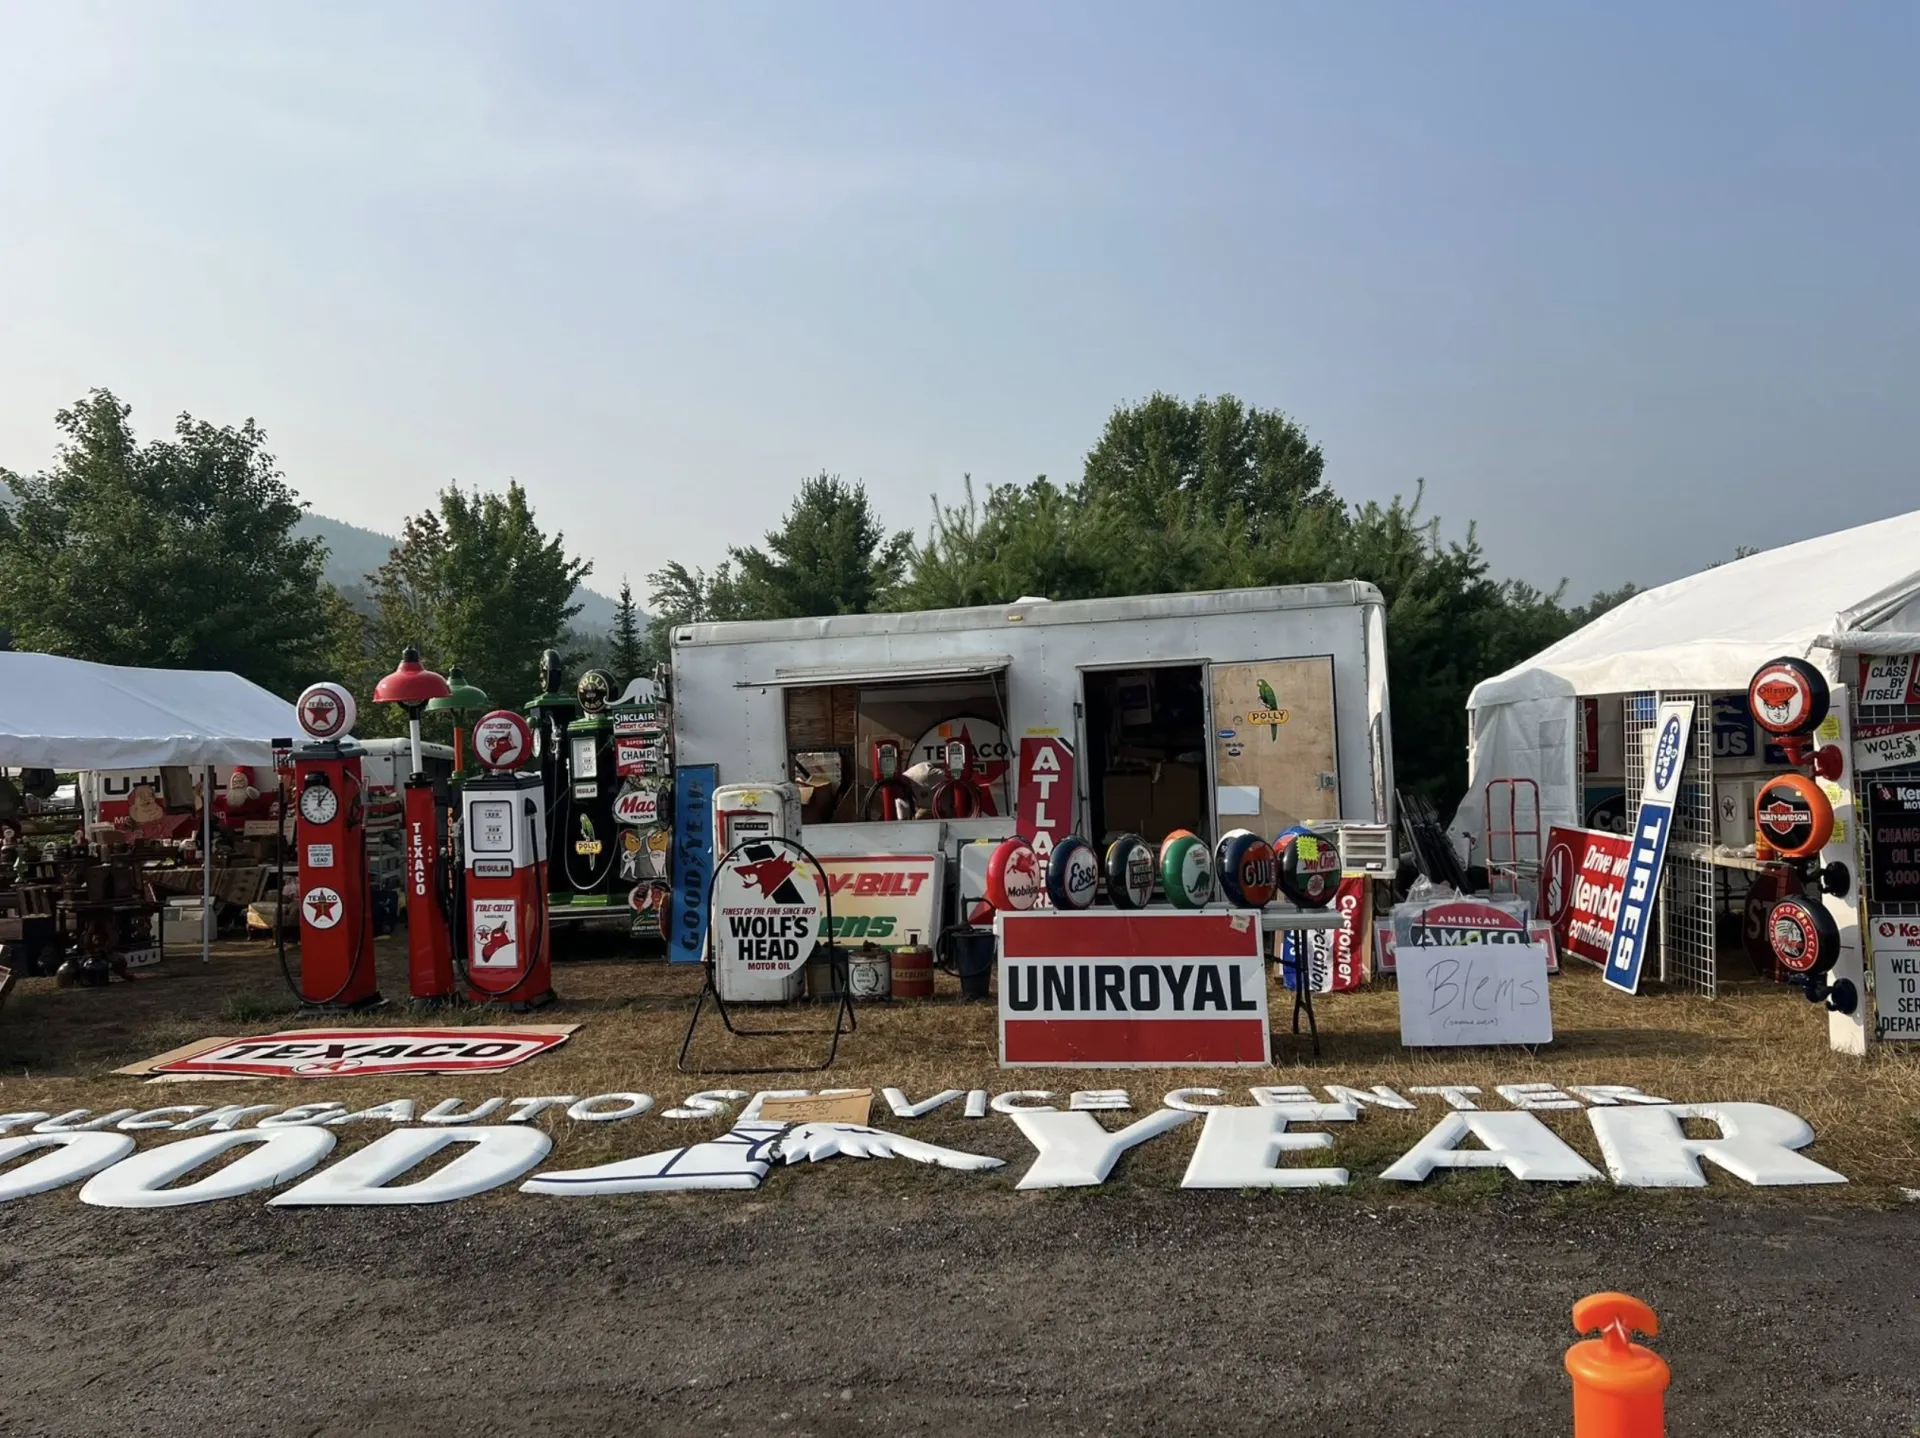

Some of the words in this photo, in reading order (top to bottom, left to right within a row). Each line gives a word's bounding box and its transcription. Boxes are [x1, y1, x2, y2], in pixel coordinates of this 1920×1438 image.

[1886, 656, 1898, 666] IN
[1901, 655, 1909, 666] A
[1872, 667, 1908, 678] CLASS
[1890, 678, 1905, 688] BY
[1866, 689, 1904, 700] ITSELF
[614, 712, 654, 724] SINCLAIR
[1252, 711, 1285, 720] POLLY
[1857, 728, 1872, 738] We
[923, 743, 1007, 760] TEACO
[1864, 735, 1912, 754] WOLF'S
[1660, 721, 1678, 787] Cooper
[1882, 750, 1916, 762] Motor
[104, 773, 227, 794] U-HL
[618, 796, 657, 814] Mac
[1760, 814, 1808, 822] HARLEY-DAVIDSON
[1877, 828, 1920, 843] CHANG
[578, 842, 599, 850] POLLY
[412, 822, 426, 895] TEXACO
[1583, 845, 1613, 874] Drive
[1892, 849, 1910, 864] OIL
[477, 865, 510, 873] REGULAR
[1245, 860, 1276, 888] GUL
[1069, 862, 1096, 893] Esso
[1886, 871, 1920, 887] 3,000
[308, 894, 338, 902] TEXACO
[1615, 818, 1662, 970] TIRES
[475, 904, 514, 912] FIRE-CHIEF
[722, 908, 744, 916] FINEST
[802, 906, 816, 914] 1879
[729, 915, 808, 938] WOLF'S
[1438, 915, 1500, 925] AMERICAN
[1338, 895, 1356, 985] Customer
[1778, 906, 1816, 960] MOTORCYCLE
[738, 939, 799, 960] HEAD
[748, 962, 776, 970] MOTOR
[778, 962, 791, 970] OIL
[1008, 965, 1257, 1011] UNIROYAL
[1426, 960, 1540, 1015] Blems
[1898, 978, 1916, 993] TO
[216, 1043, 522, 1060] TEXACO
[322, 1092, 654, 1125] AUTO
[660, 1088, 1131, 1121] SEVICE
[1163, 1083, 1672, 1112] CENTER
[1009, 1101, 1849, 1190] YEAR
